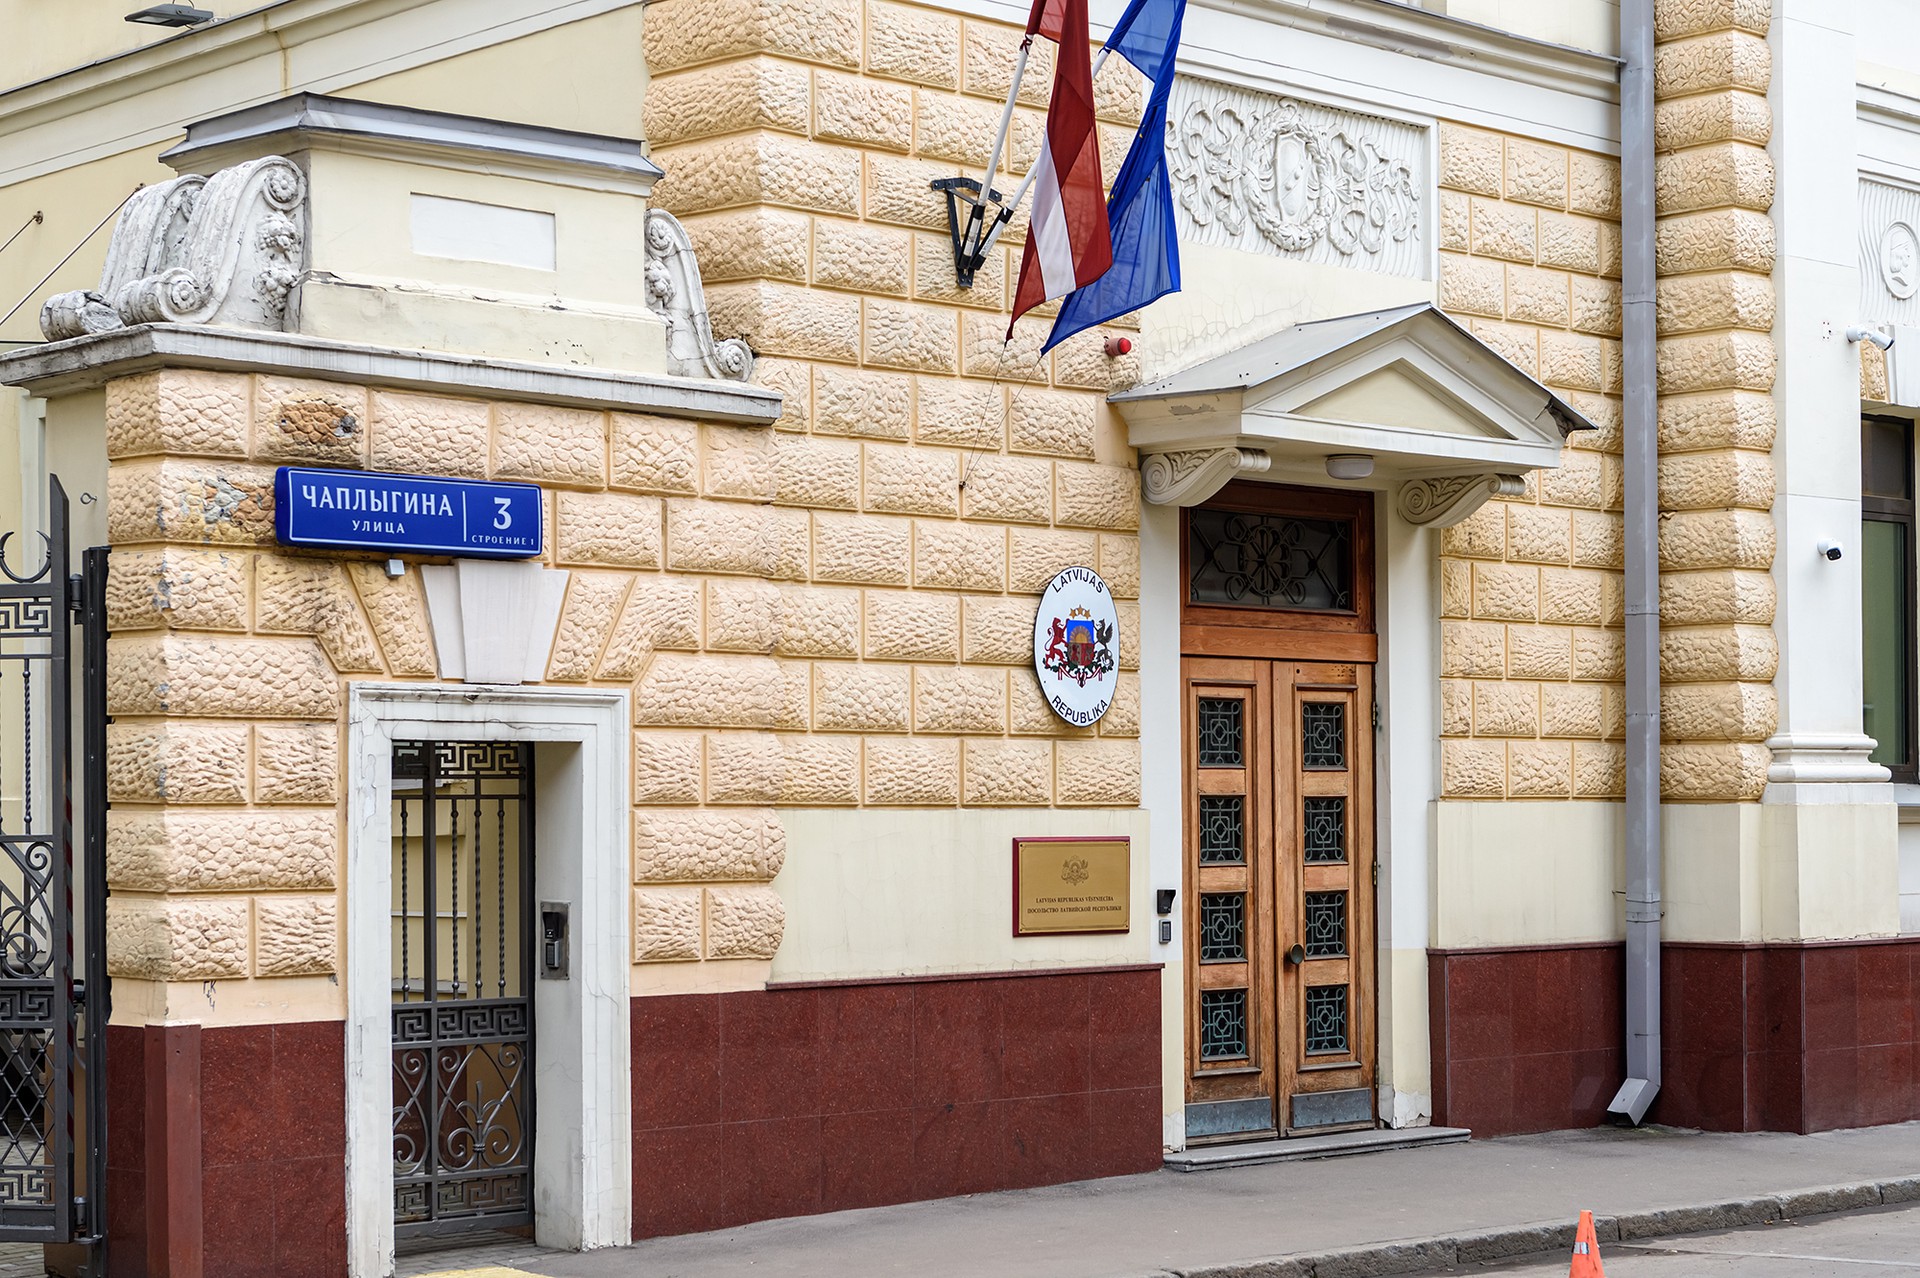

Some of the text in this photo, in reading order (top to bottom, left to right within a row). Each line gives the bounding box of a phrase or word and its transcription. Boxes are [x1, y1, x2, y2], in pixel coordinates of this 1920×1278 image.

[302, 485, 454, 517] ЧАПЛЫГИНА
[493, 497, 513, 530] 3
[352, 519, 405, 534] УЛИЦА
[471, 534, 534, 546] СТРОЕНИЕ 1
[1052, 569, 1104, 593] LATVIJAS
[1052, 695, 1108, 724] REPUBLIKA
